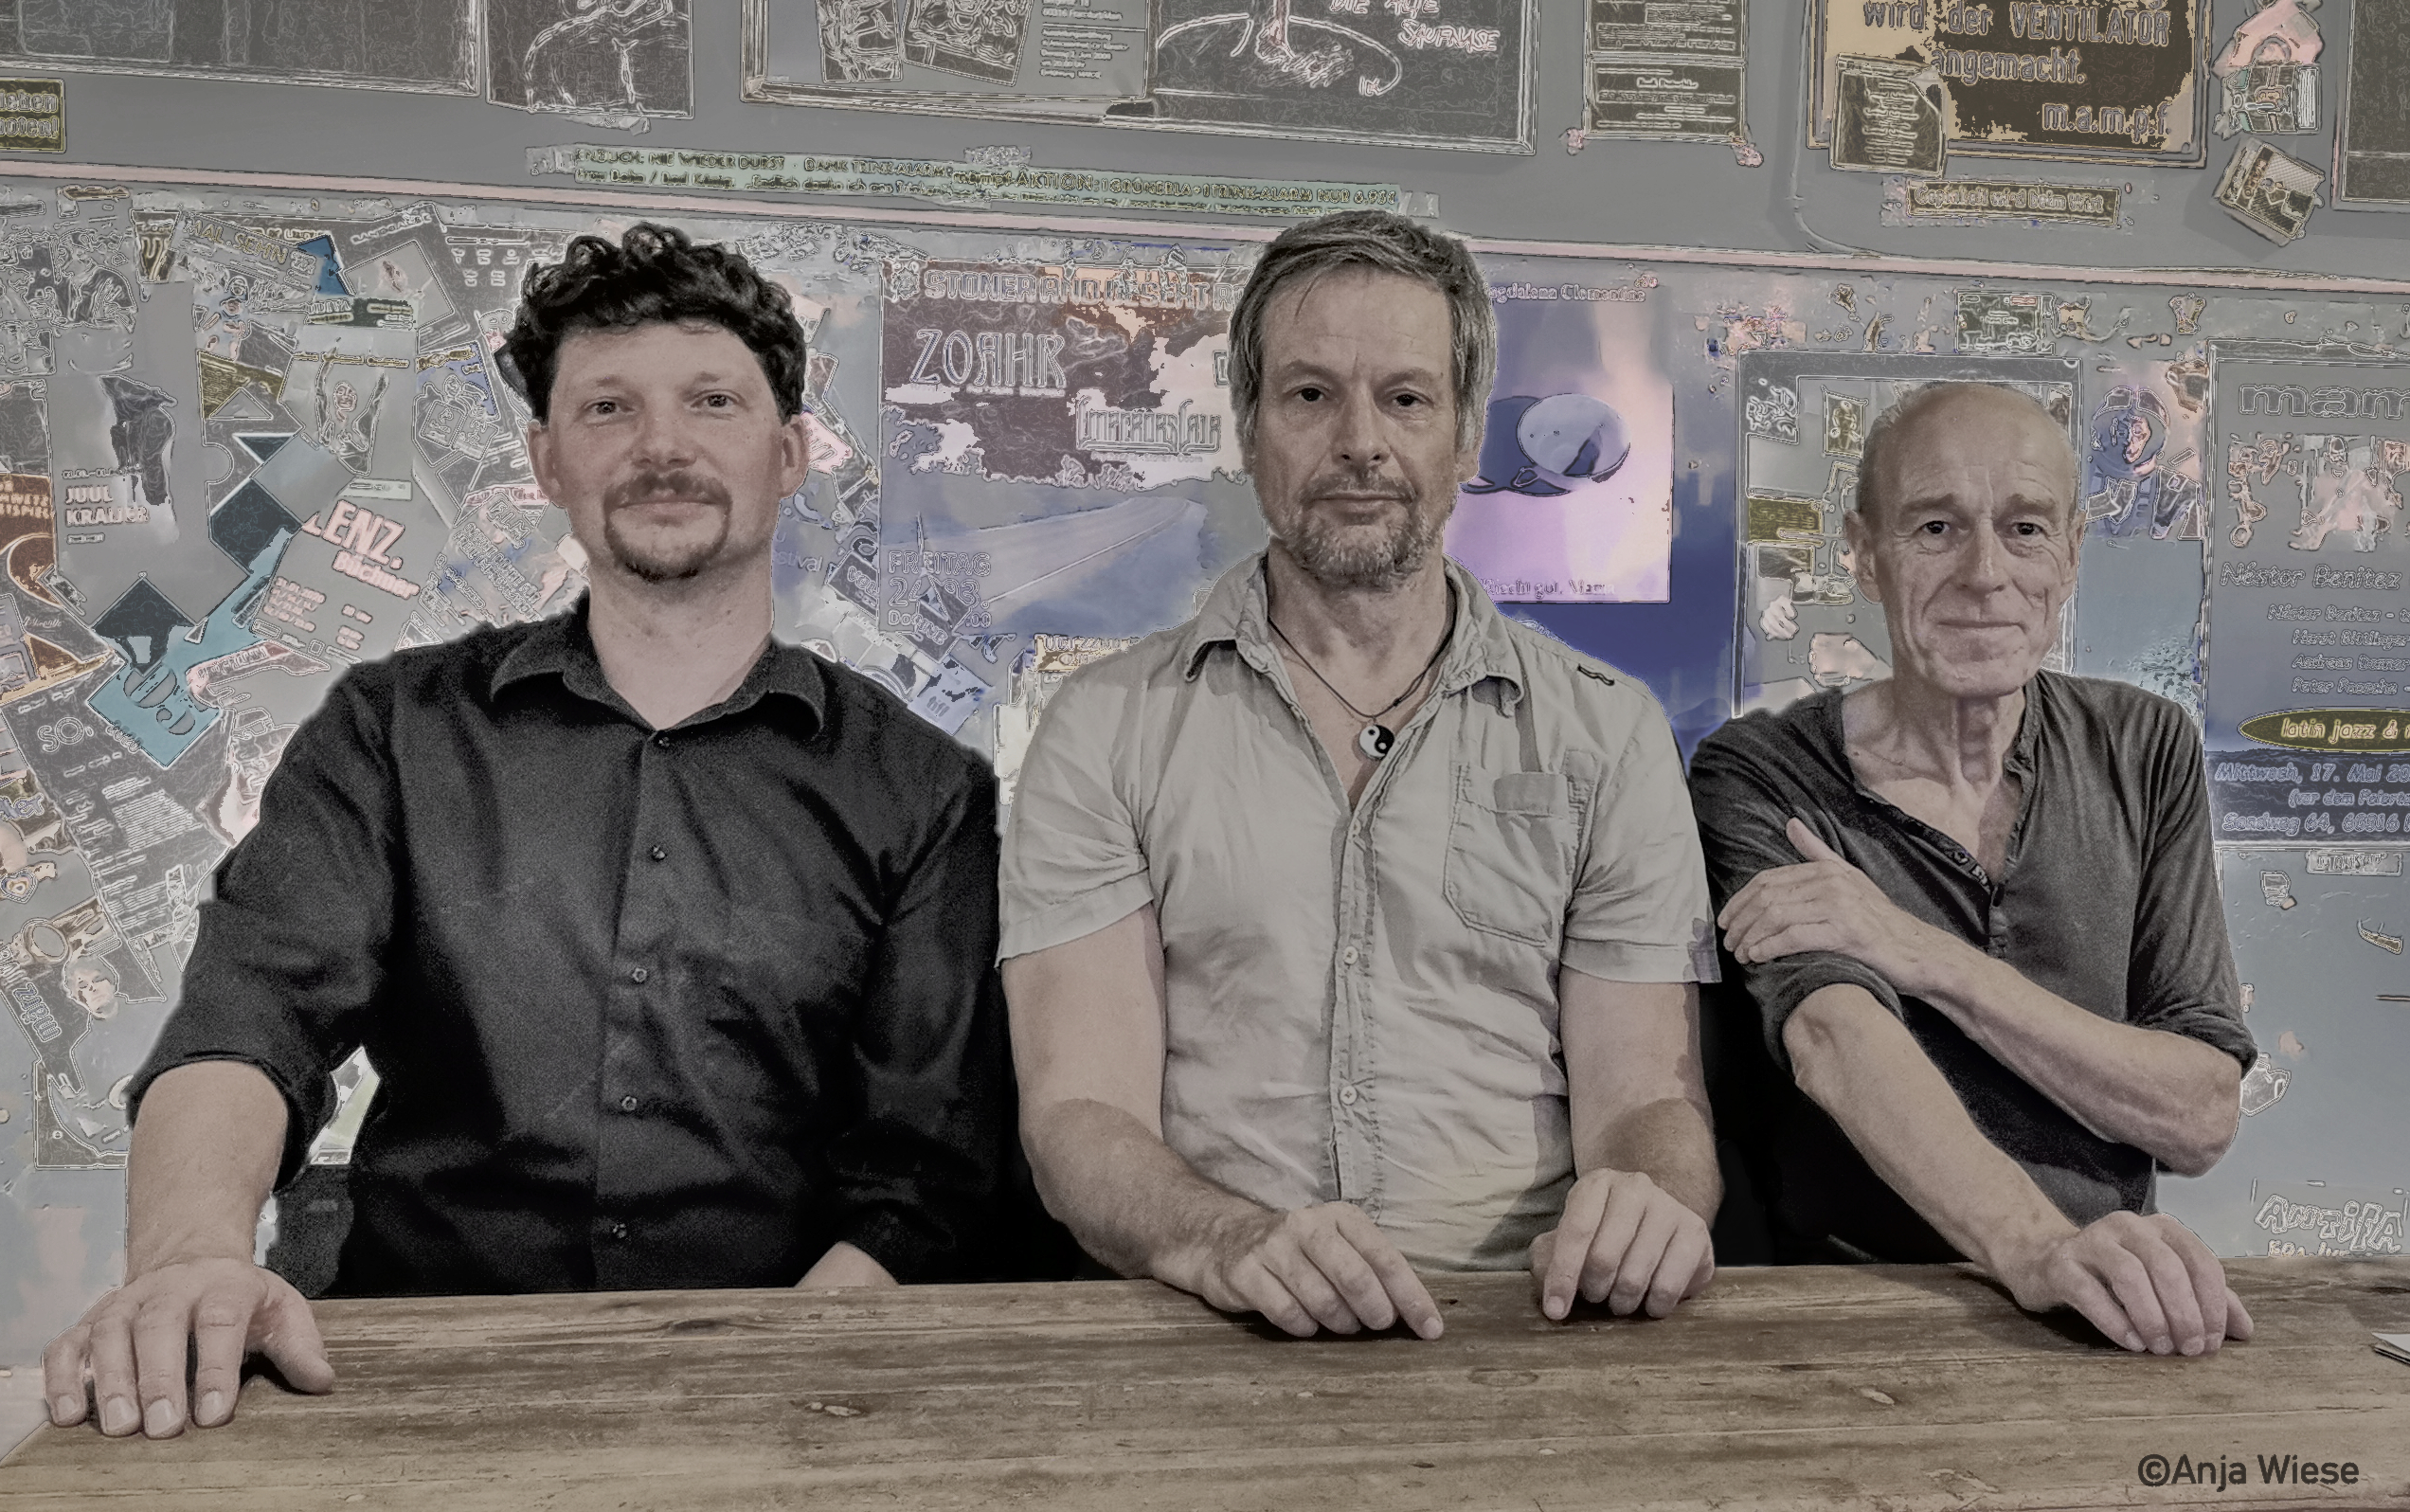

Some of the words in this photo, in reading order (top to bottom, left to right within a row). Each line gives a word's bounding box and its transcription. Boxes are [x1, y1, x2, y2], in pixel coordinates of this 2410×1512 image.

[1862, 2, 1925, 30] wird
[1948, 4, 1992, 35] der
[2010, 1, 2170, 46] VENTILATOR
[1931, 47, 2085, 85] angemacht.
[678, 152, 735, 169] WIEDER
[739, 154, 784, 171] DURST
[924, 269, 1036, 301] STONER
[888, 550, 991, 576] FREITAG
[2220, 561, 2306, 588] Néstor
[2312, 563, 2402, 590] Benitez
[2281, 717, 2326, 738] latin
[2328, 719, 2377, 745] jazz
[2382, 719, 2399, 739] &
[2214, 762, 2303, 784] Mittwoch,
[2347, 764, 2383, 783] Mai
[2322, 789, 2355, 805] dem
[2222, 812, 2301, 837] Sandweg
